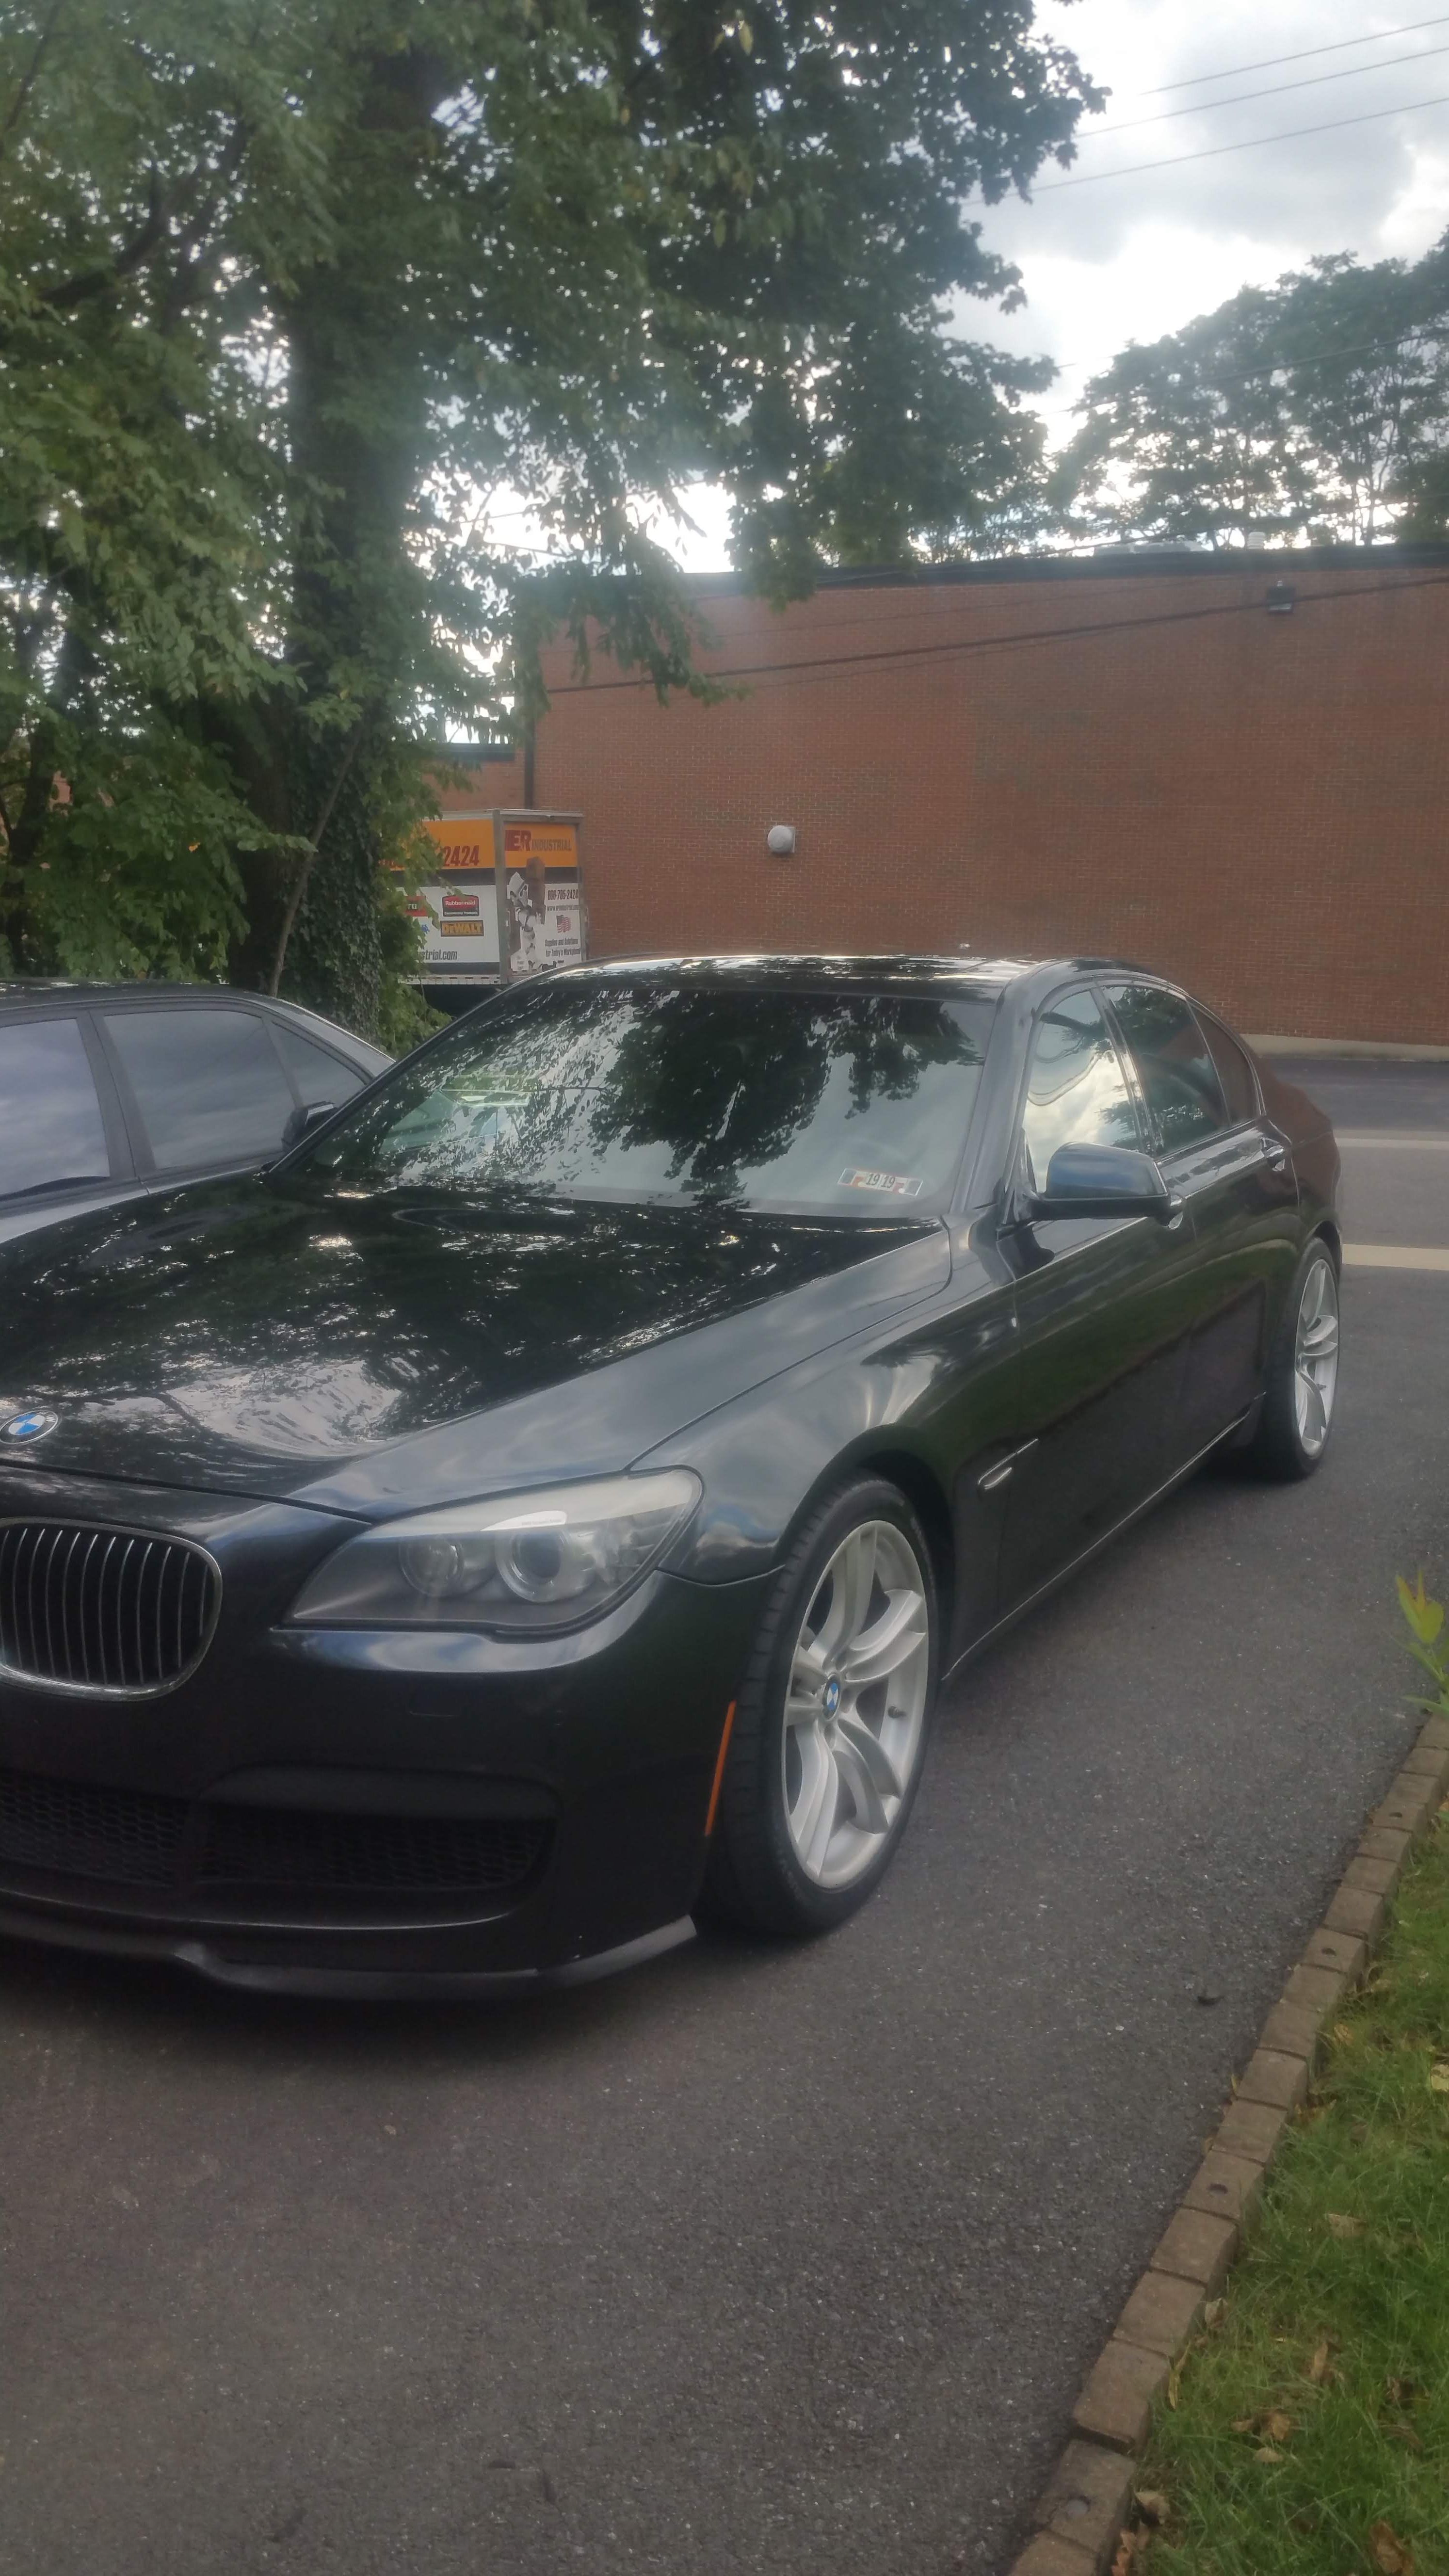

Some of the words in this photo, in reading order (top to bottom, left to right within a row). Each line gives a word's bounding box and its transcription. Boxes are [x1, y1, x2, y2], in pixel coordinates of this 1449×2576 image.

[532, 838, 572, 851] INDUSTRIAL
[443, 845, 479, 867] 2424
[866, 1173, 880, 1186] 19
[881, 1175, 896, 1189] 19
